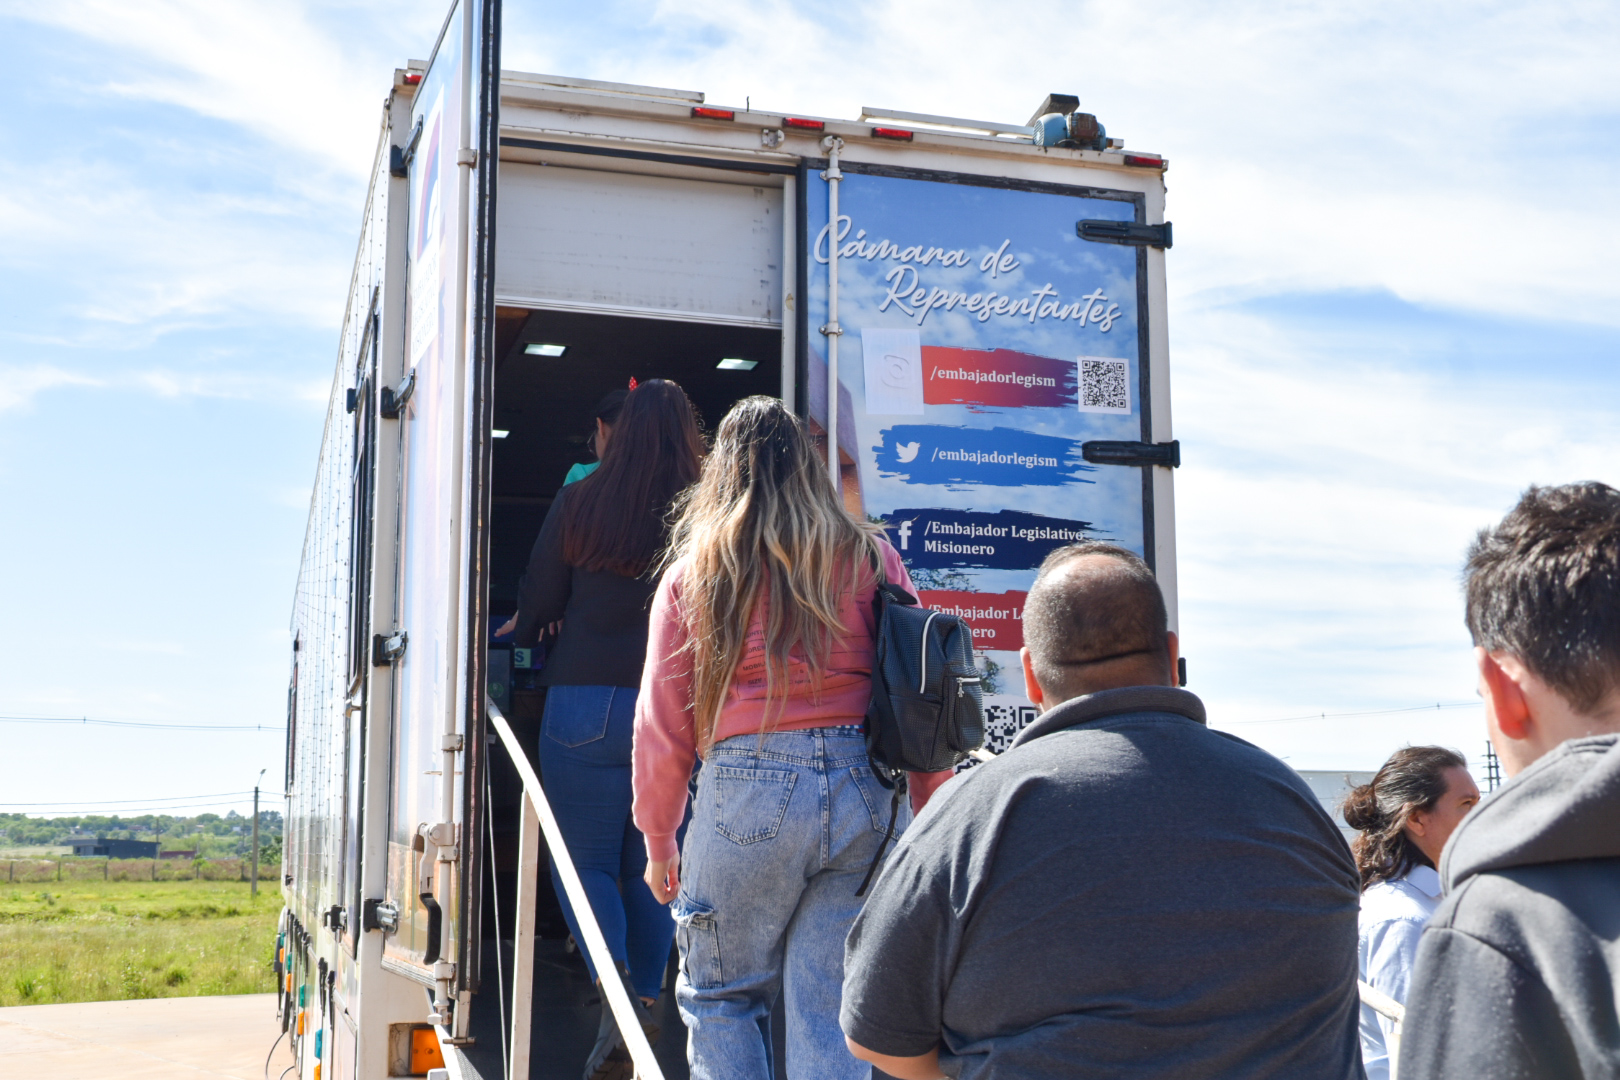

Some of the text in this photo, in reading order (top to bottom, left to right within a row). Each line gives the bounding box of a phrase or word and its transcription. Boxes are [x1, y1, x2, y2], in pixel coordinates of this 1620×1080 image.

[813, 214, 1019, 278] Cámara de
[879, 264, 1121, 332] Representantes
[930, 366, 1056, 388] /embajadorlegism
[931, 447, 1058, 468] /embajadorlegism
[924, 520, 1084, 541] /Embajador Legislativo
[924, 540, 995, 555] Misionero
